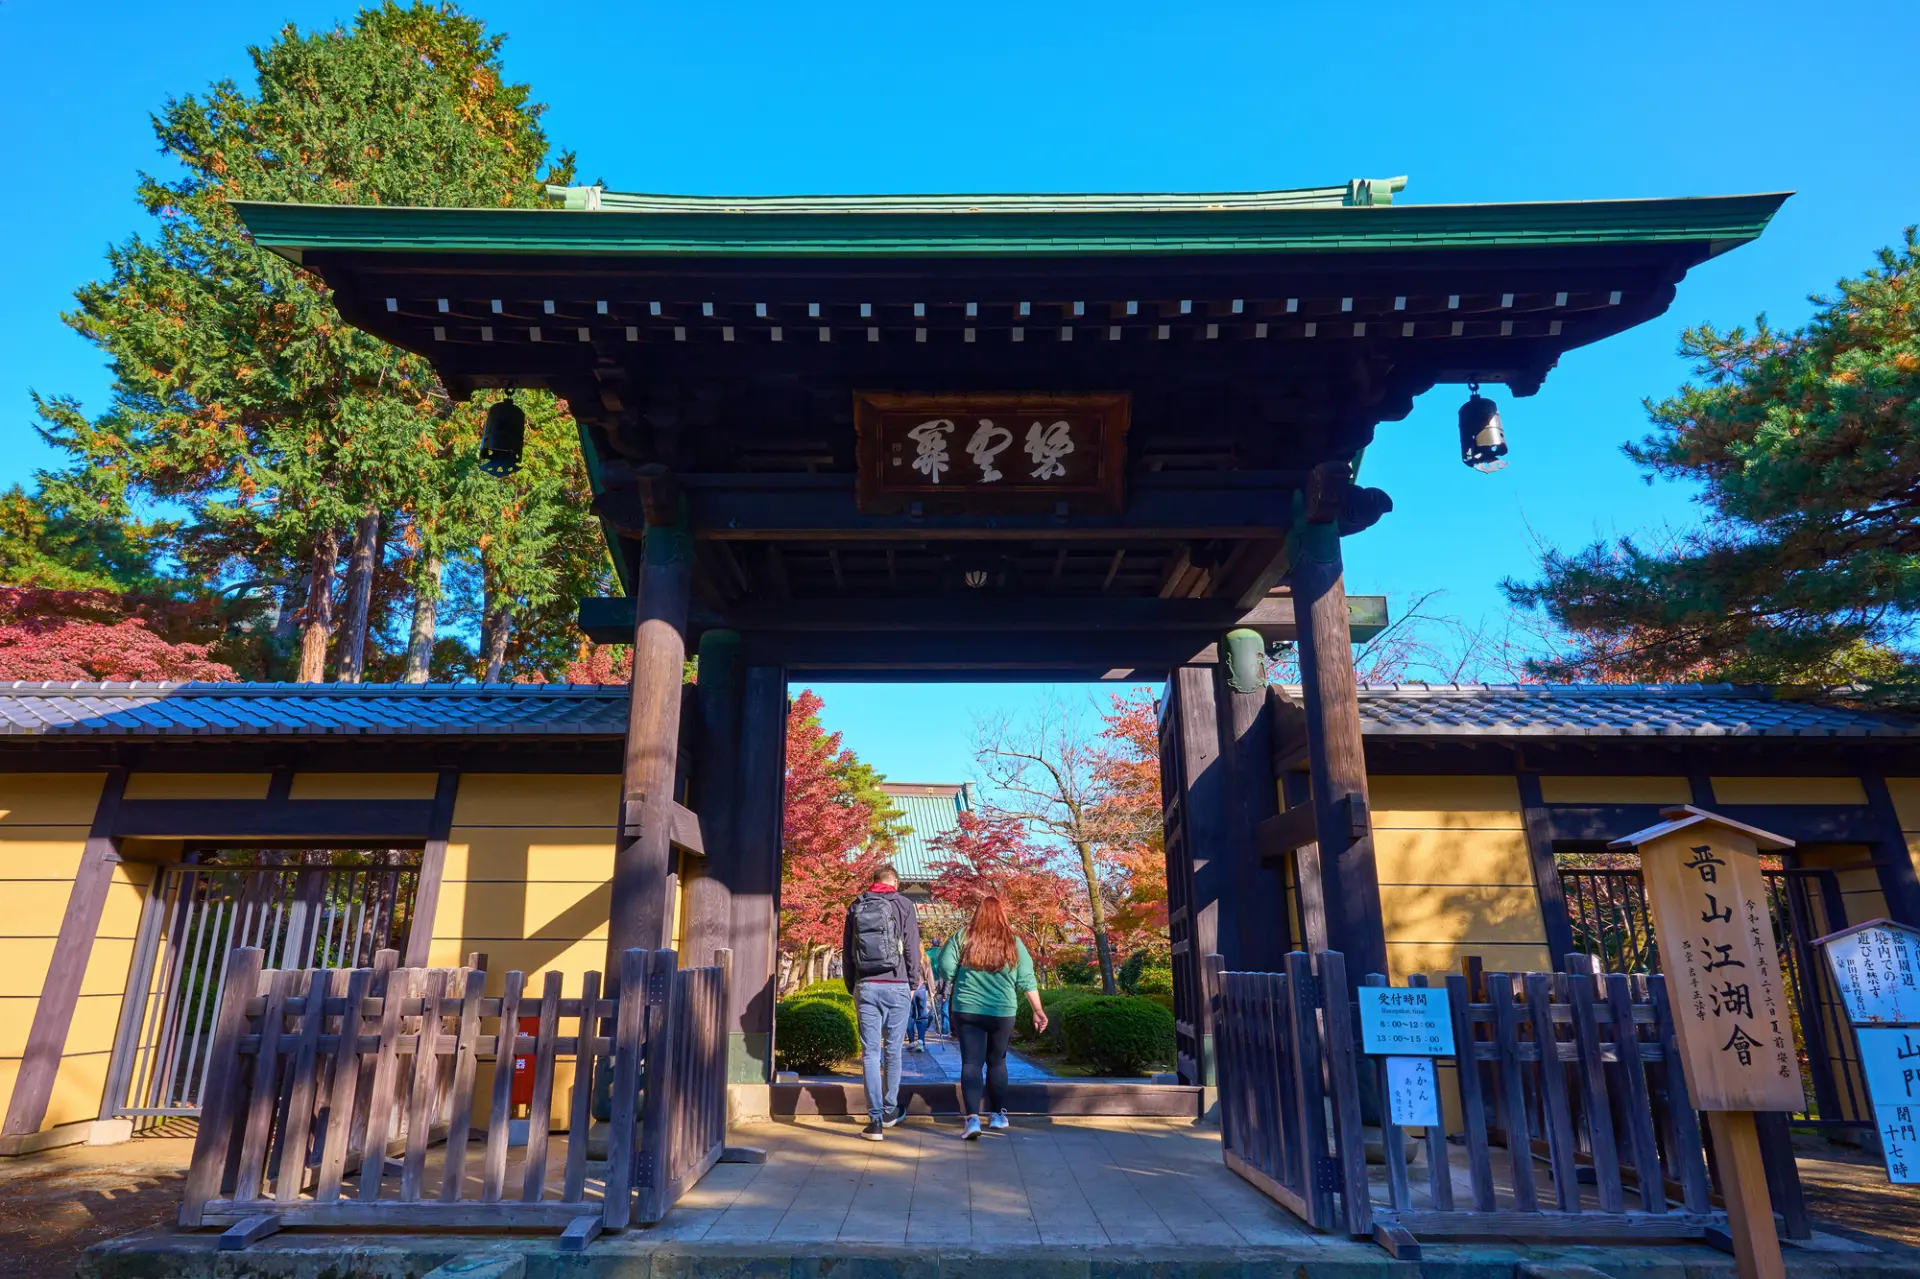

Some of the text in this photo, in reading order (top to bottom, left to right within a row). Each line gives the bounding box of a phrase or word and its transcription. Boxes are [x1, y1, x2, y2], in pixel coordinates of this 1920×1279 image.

[1377, 992, 1428, 1006] 受付時間
[1404, 1076, 1415, 1120] あります
[1415, 1062, 1429, 1101] みかん
[1884, 1124, 1909, 1179] 十七時
